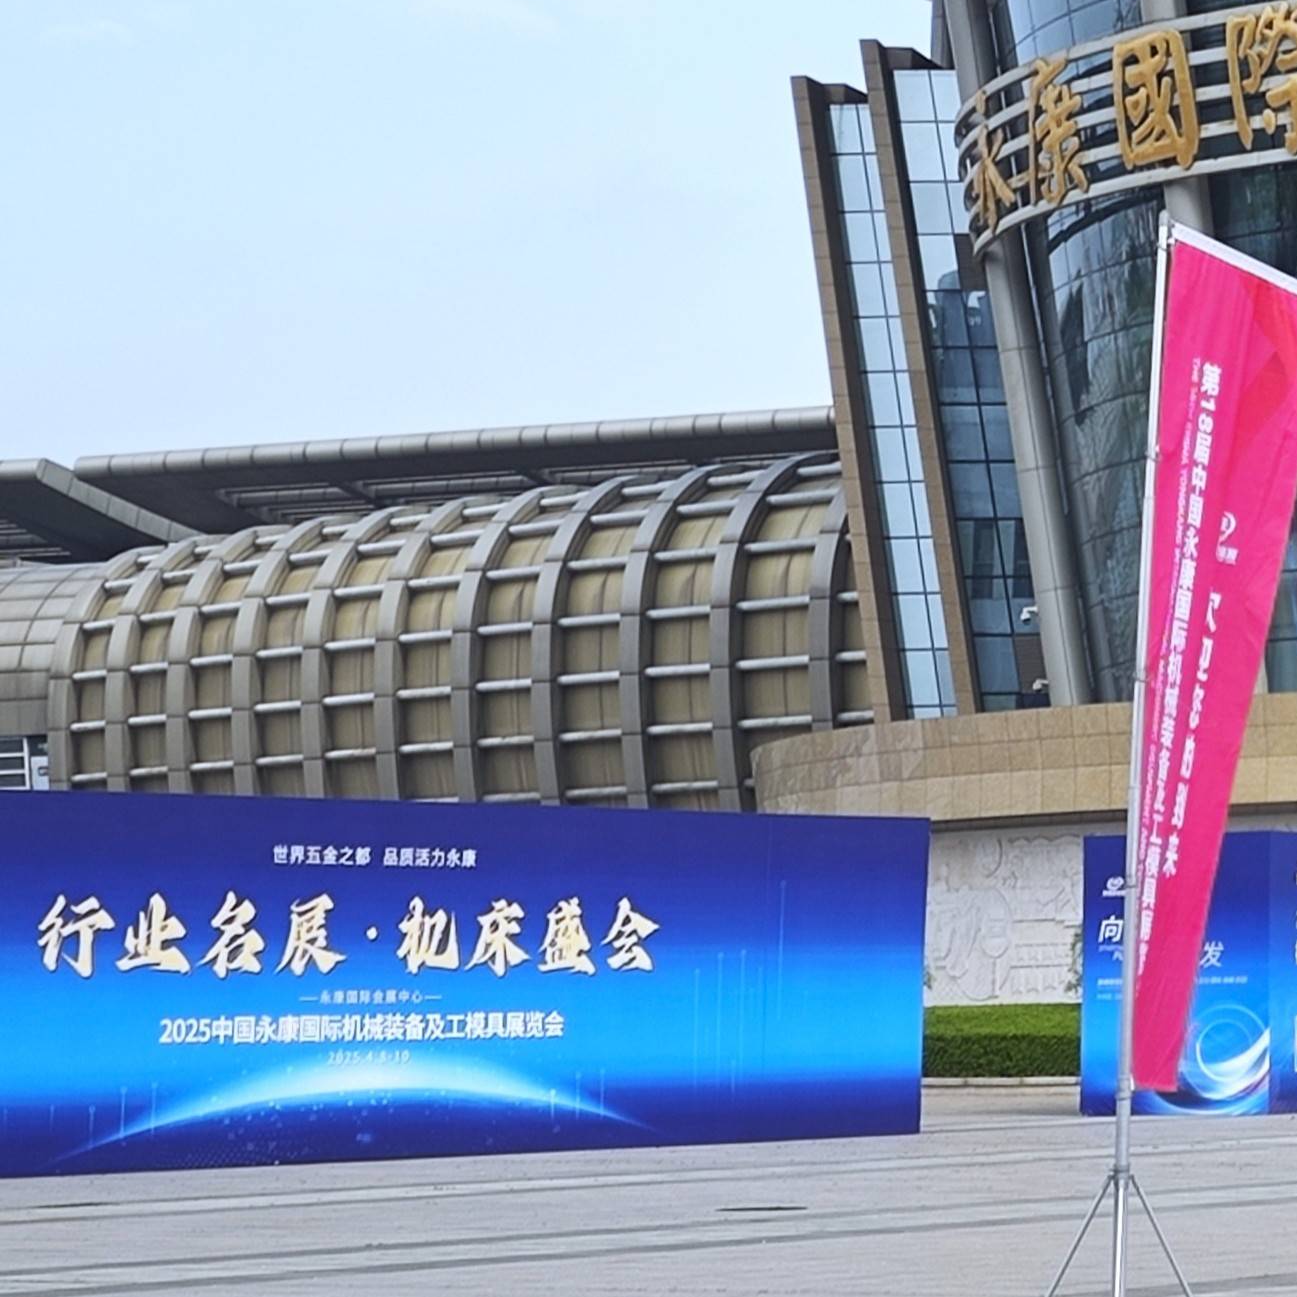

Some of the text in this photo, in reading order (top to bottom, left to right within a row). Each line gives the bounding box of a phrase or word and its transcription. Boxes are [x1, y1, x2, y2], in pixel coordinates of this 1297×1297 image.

[272, 844, 477, 868] 世界五金之都 品质活力永康
[158, 1011, 566, 1046] 2025中国永康国际机械装备及工模具展览会
